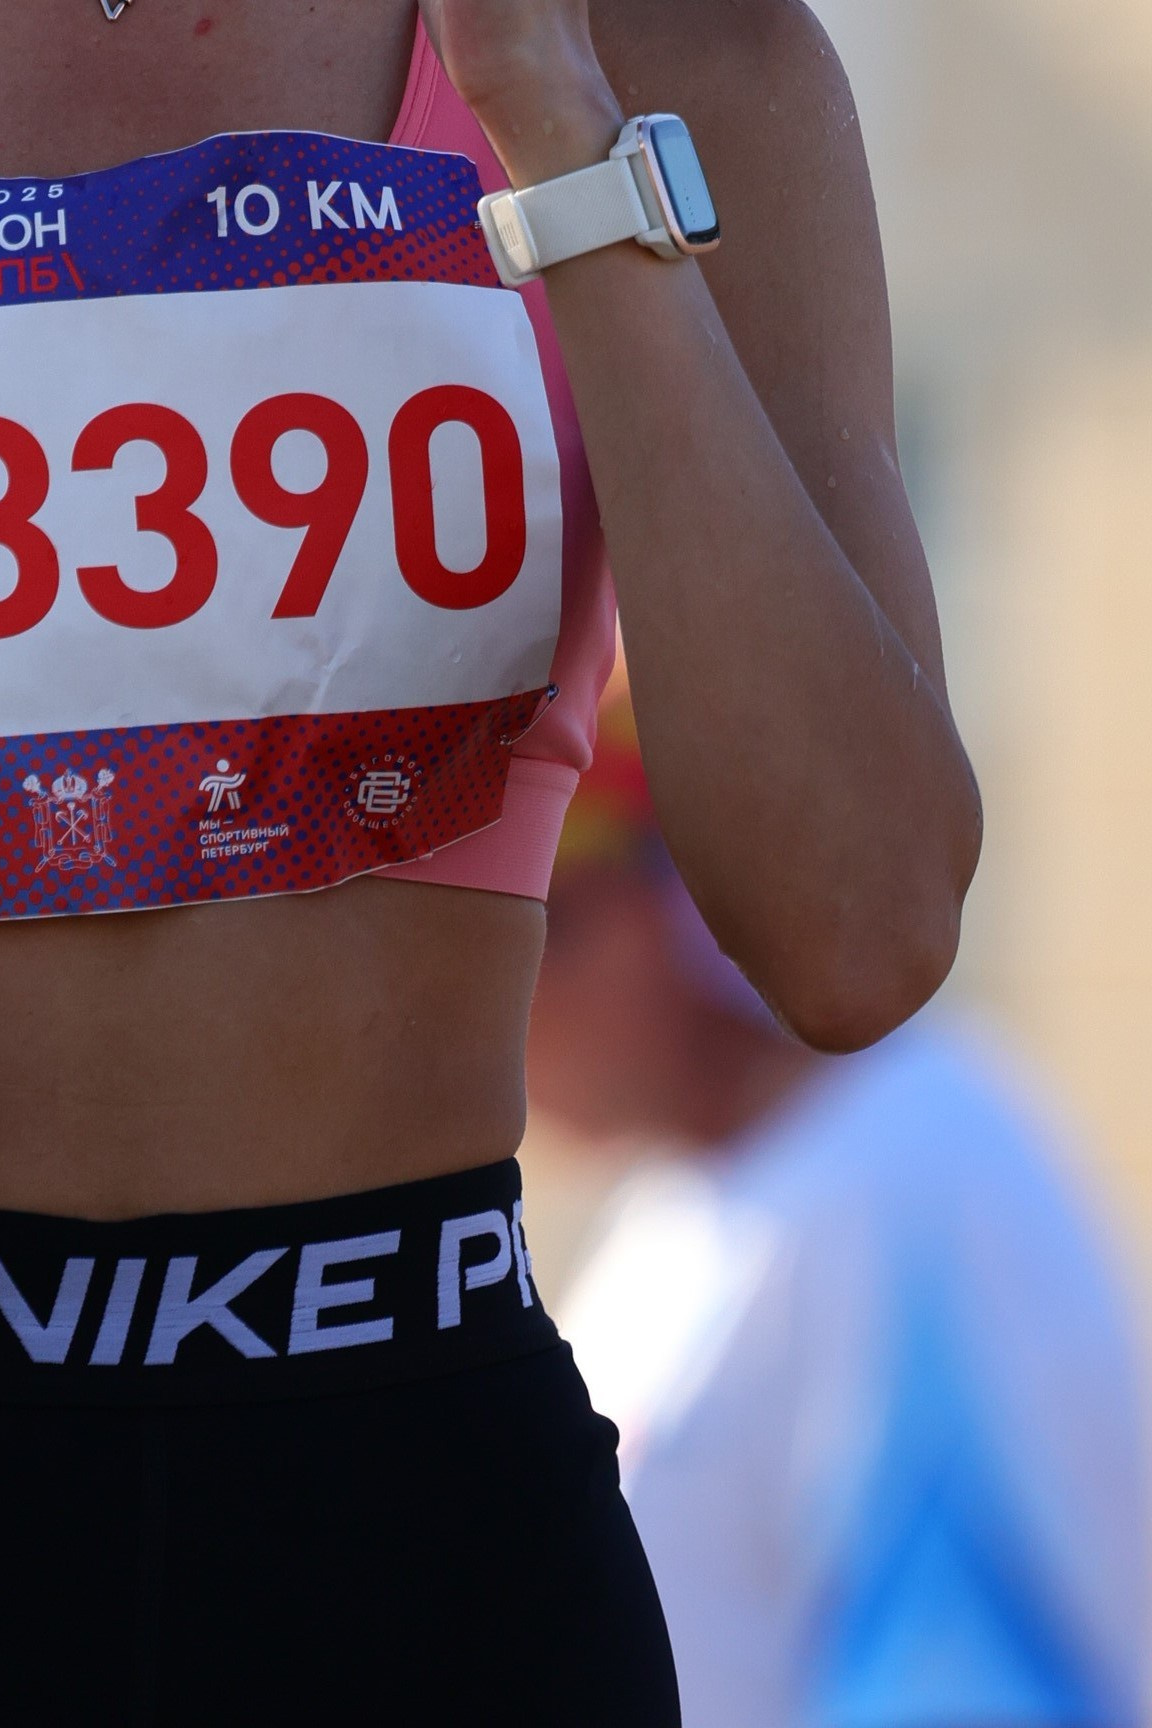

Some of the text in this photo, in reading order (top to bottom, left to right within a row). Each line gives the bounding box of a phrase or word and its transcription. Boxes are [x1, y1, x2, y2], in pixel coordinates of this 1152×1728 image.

[206, 180, 403, 238] 10 КМ
[199, 819, 221, 832] МЫ
[200, 823, 290, 845] СПОРТИВНЫЙ
[201, 841, 270, 860] ПЕТЕРБУРГ
